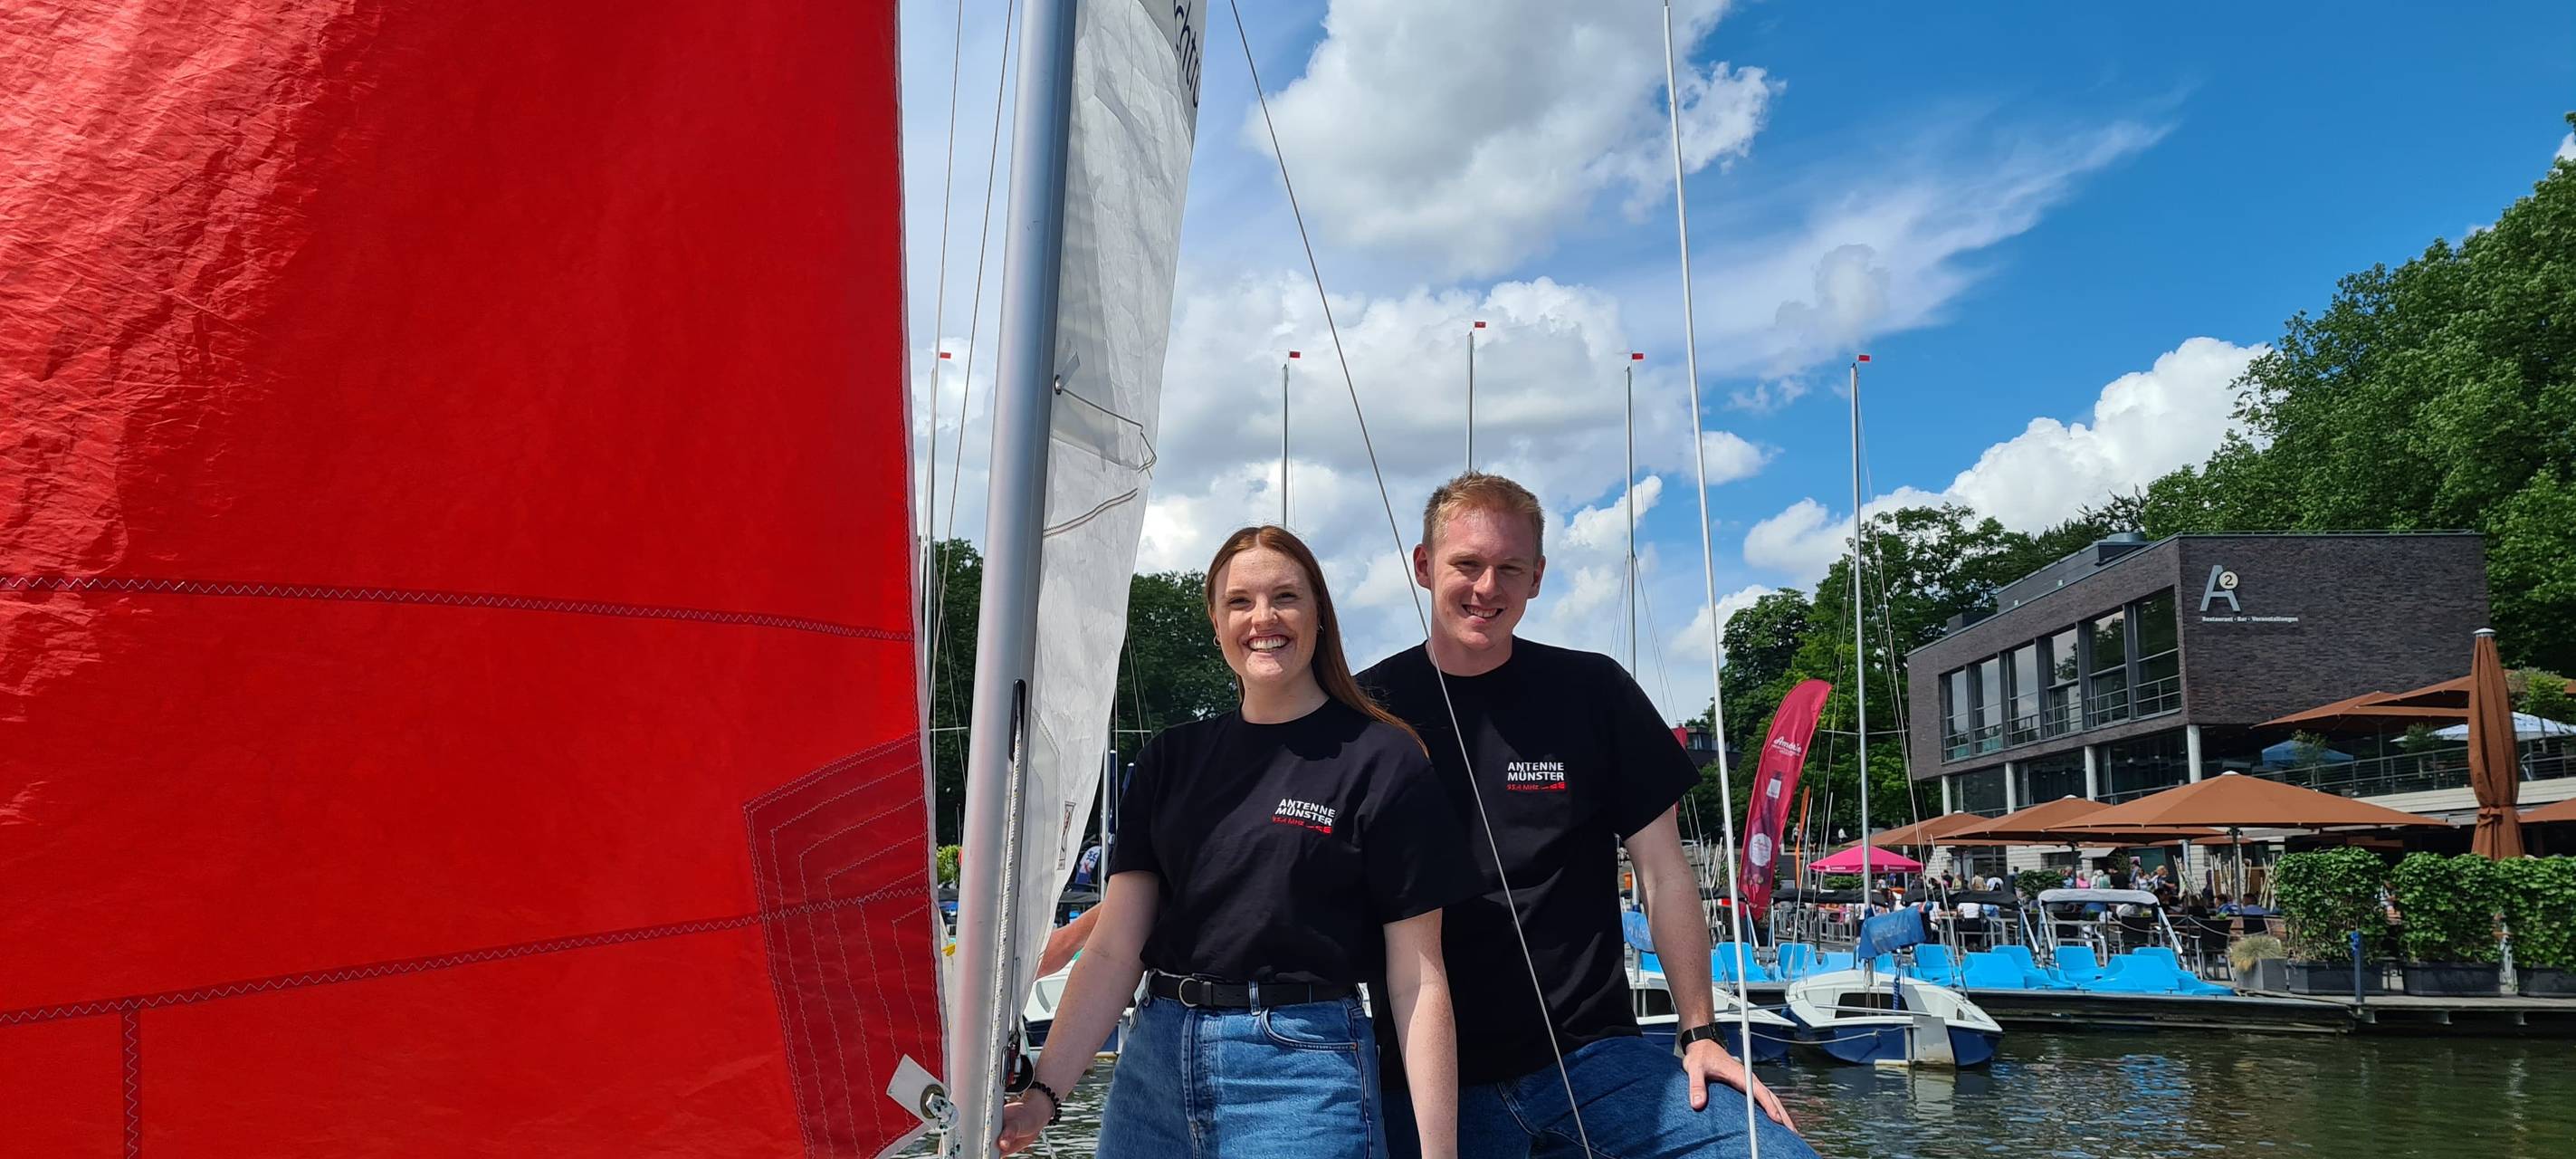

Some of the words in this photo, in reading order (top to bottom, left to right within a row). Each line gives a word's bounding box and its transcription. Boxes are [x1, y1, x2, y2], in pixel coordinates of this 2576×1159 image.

[1507, 761, 1565, 771] ANTENNE
[1507, 770, 1565, 781] MÜNSTER
[1274, 805, 1333, 827] MÜNSTER
[1278, 799, 1336, 818] ANTENNE
